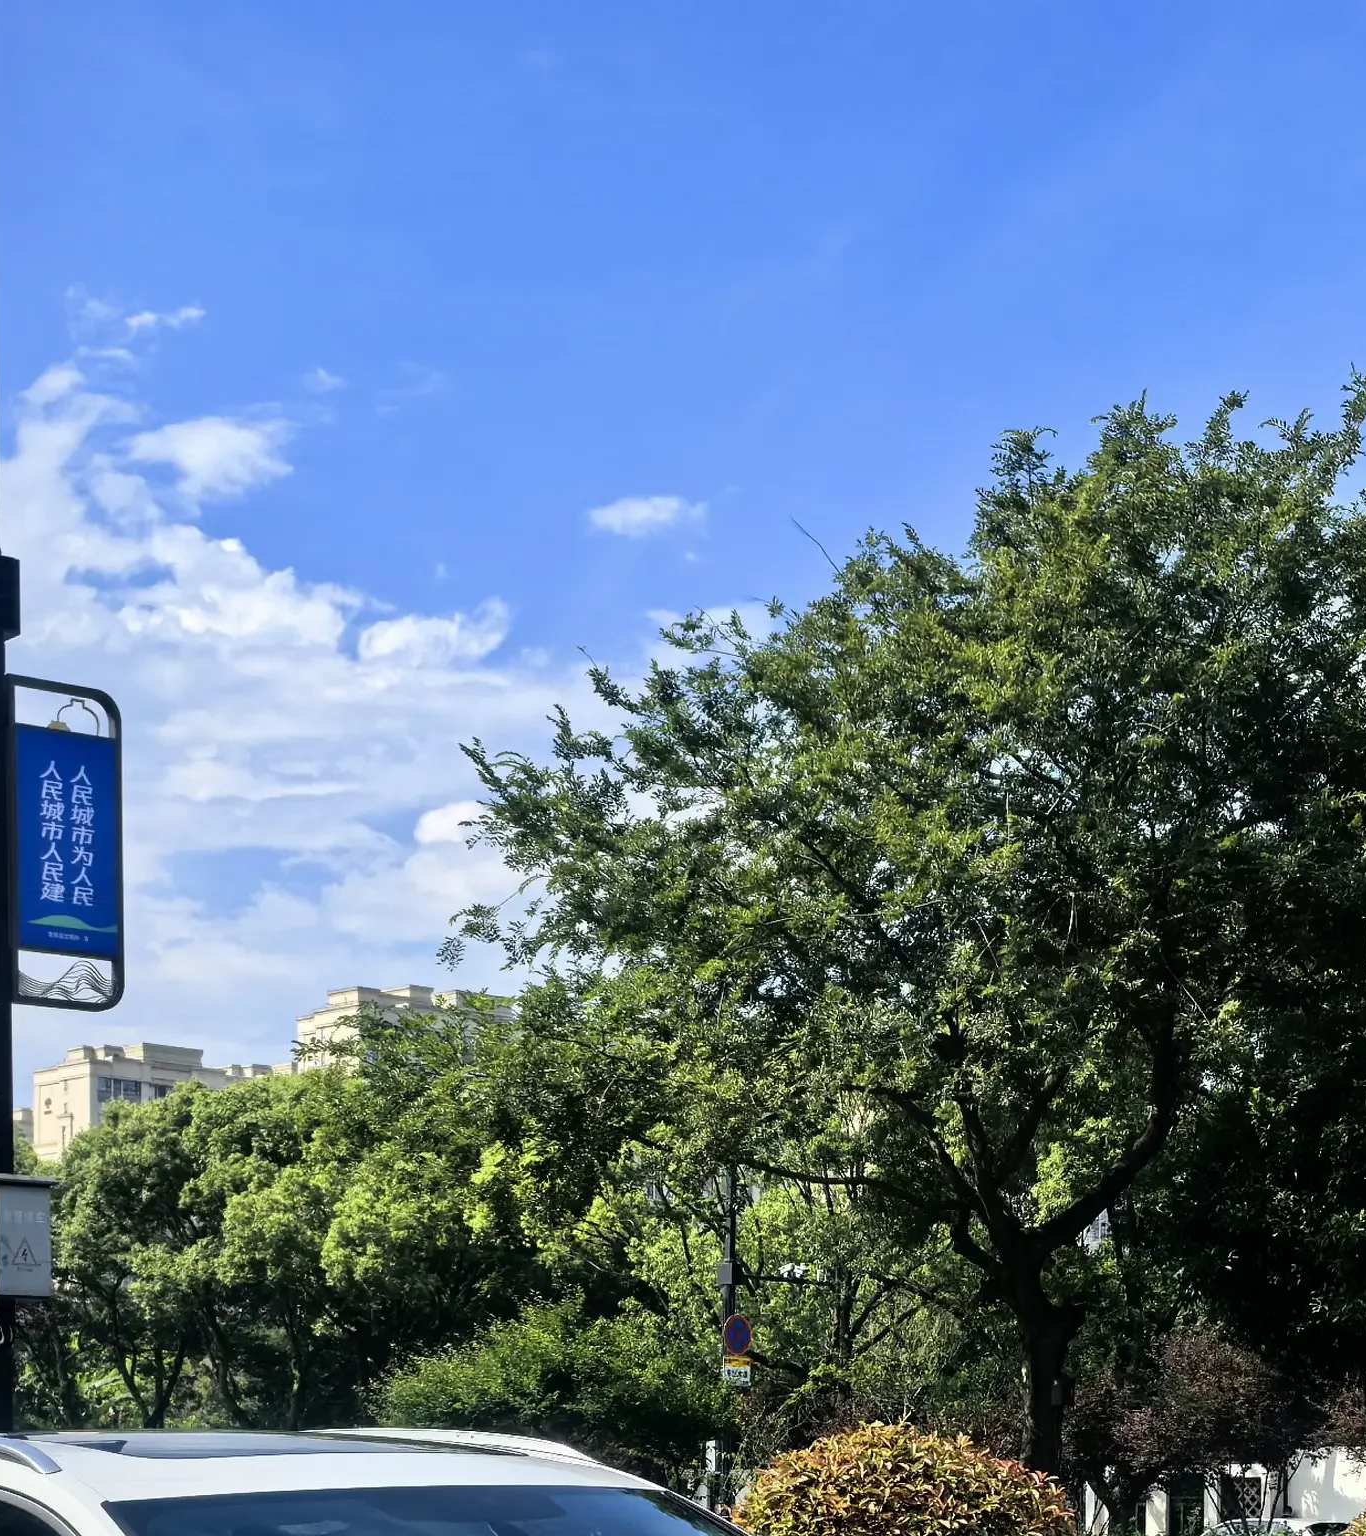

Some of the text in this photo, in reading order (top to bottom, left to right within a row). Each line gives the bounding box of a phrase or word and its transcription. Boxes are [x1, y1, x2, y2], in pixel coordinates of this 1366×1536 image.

[39, 760, 66, 903] 人民城市人民建
[69, 765, 96, 907] 人民城市为人民
